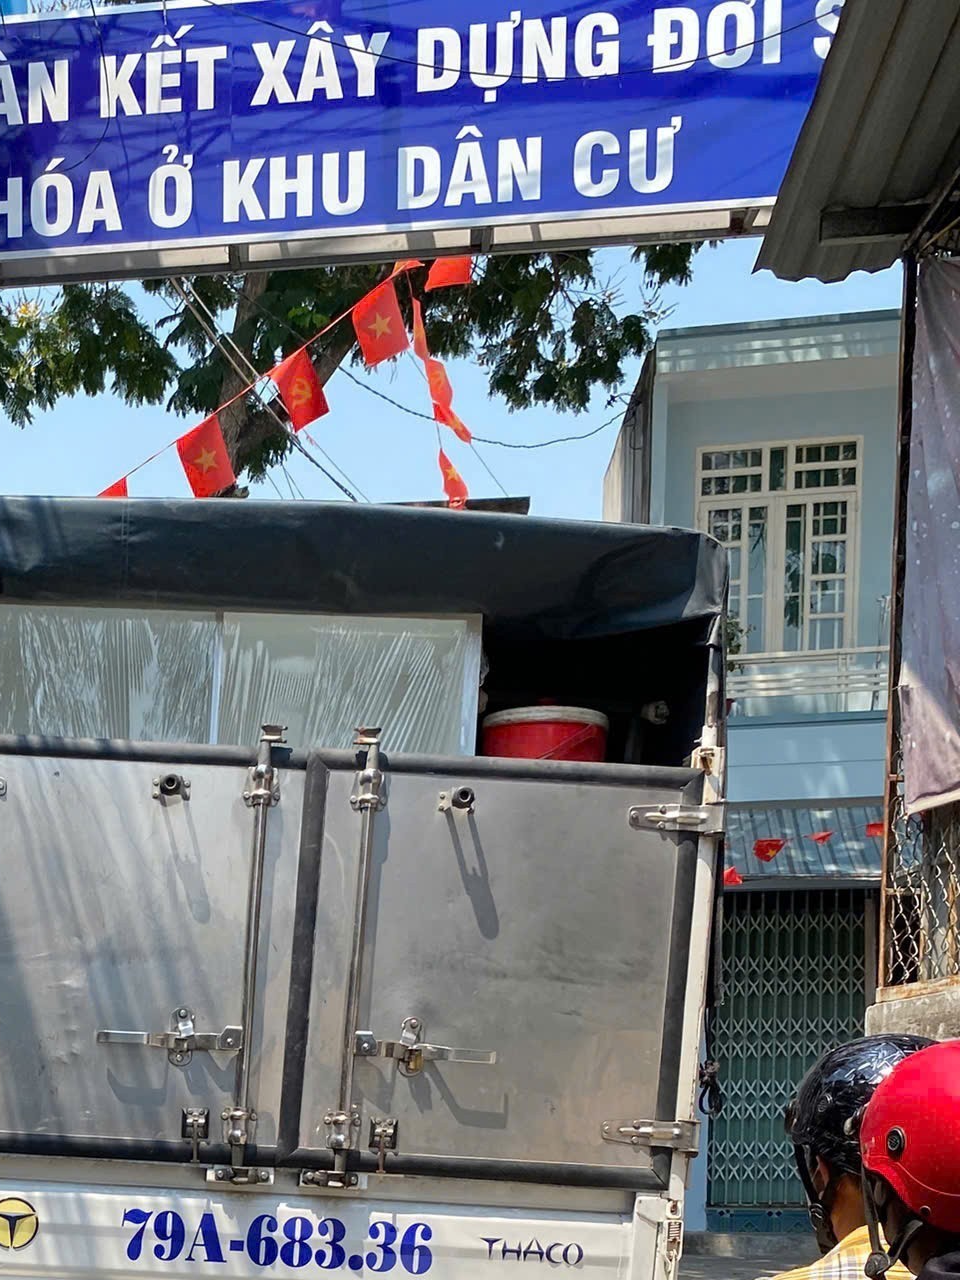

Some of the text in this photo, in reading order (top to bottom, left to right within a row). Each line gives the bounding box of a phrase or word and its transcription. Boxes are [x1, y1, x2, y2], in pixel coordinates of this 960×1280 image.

[100, 24, 227, 118] KẾT
[251, 20, 390, 107] XÂY
[416, 10, 620, 103] DỰNG
[149, 144, 195, 229] Ở
[223, 151, 366, 224] KHU
[397, 125, 542, 210] DÂN
[573, 116, 681, 198] CƯ
[121, 1207, 433, 1277] 79A-683.36
[479, 1236, 584, 1265] THACO
